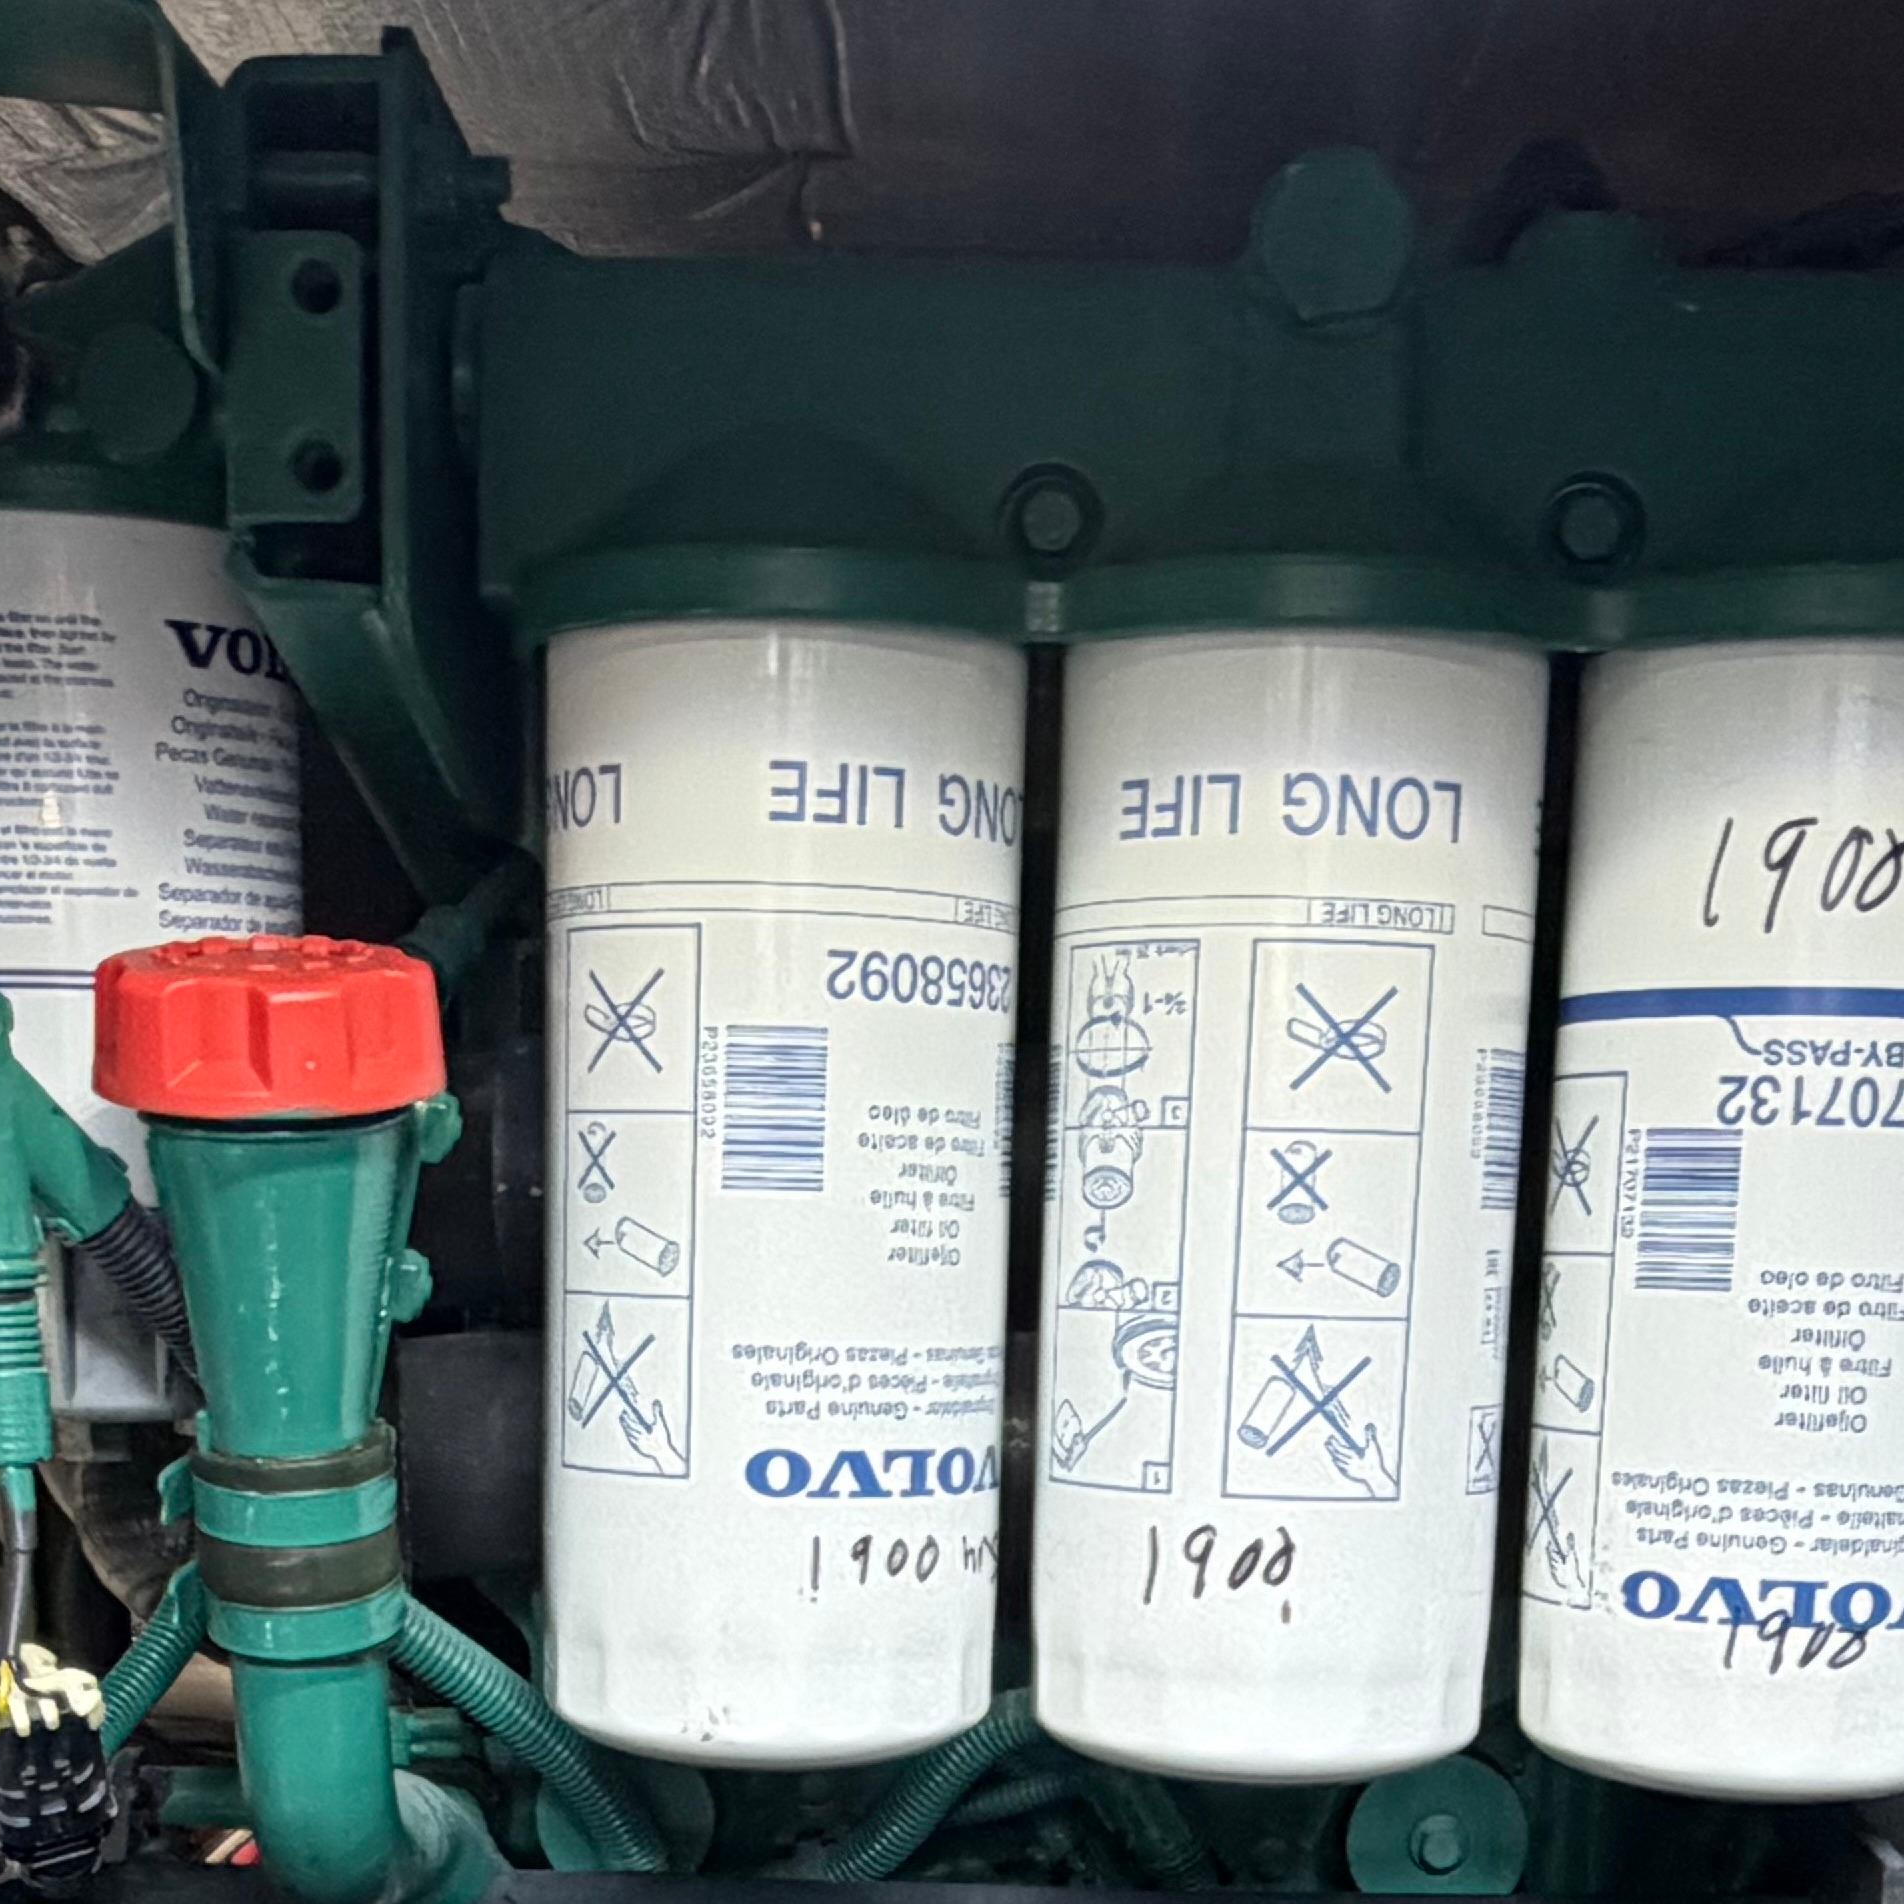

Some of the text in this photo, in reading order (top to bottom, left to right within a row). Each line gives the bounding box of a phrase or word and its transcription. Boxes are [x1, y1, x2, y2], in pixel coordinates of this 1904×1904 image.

[547, 763, 622, 831] LON
[768, 760, 1023, 847] ONG LIFE
[1120, 772, 1463, 844] LONG LIFE
[1320, 902, 1436, 929] LONG LIFE
[826, 950, 1012, 1013] 23658092
[1814, 1271, 1845, 1293] de
[1747, 1297, 1818, 1320] aceite
[1822, 1299, 1853, 1322] de
[1773, 1410, 1868, 1434] Oljefilter
[745, 1446, 999, 1498] VOLVO
[1716, 1477, 1790, 1502] Piezas
[1695, 1530, 1788, 1555] Genuine
